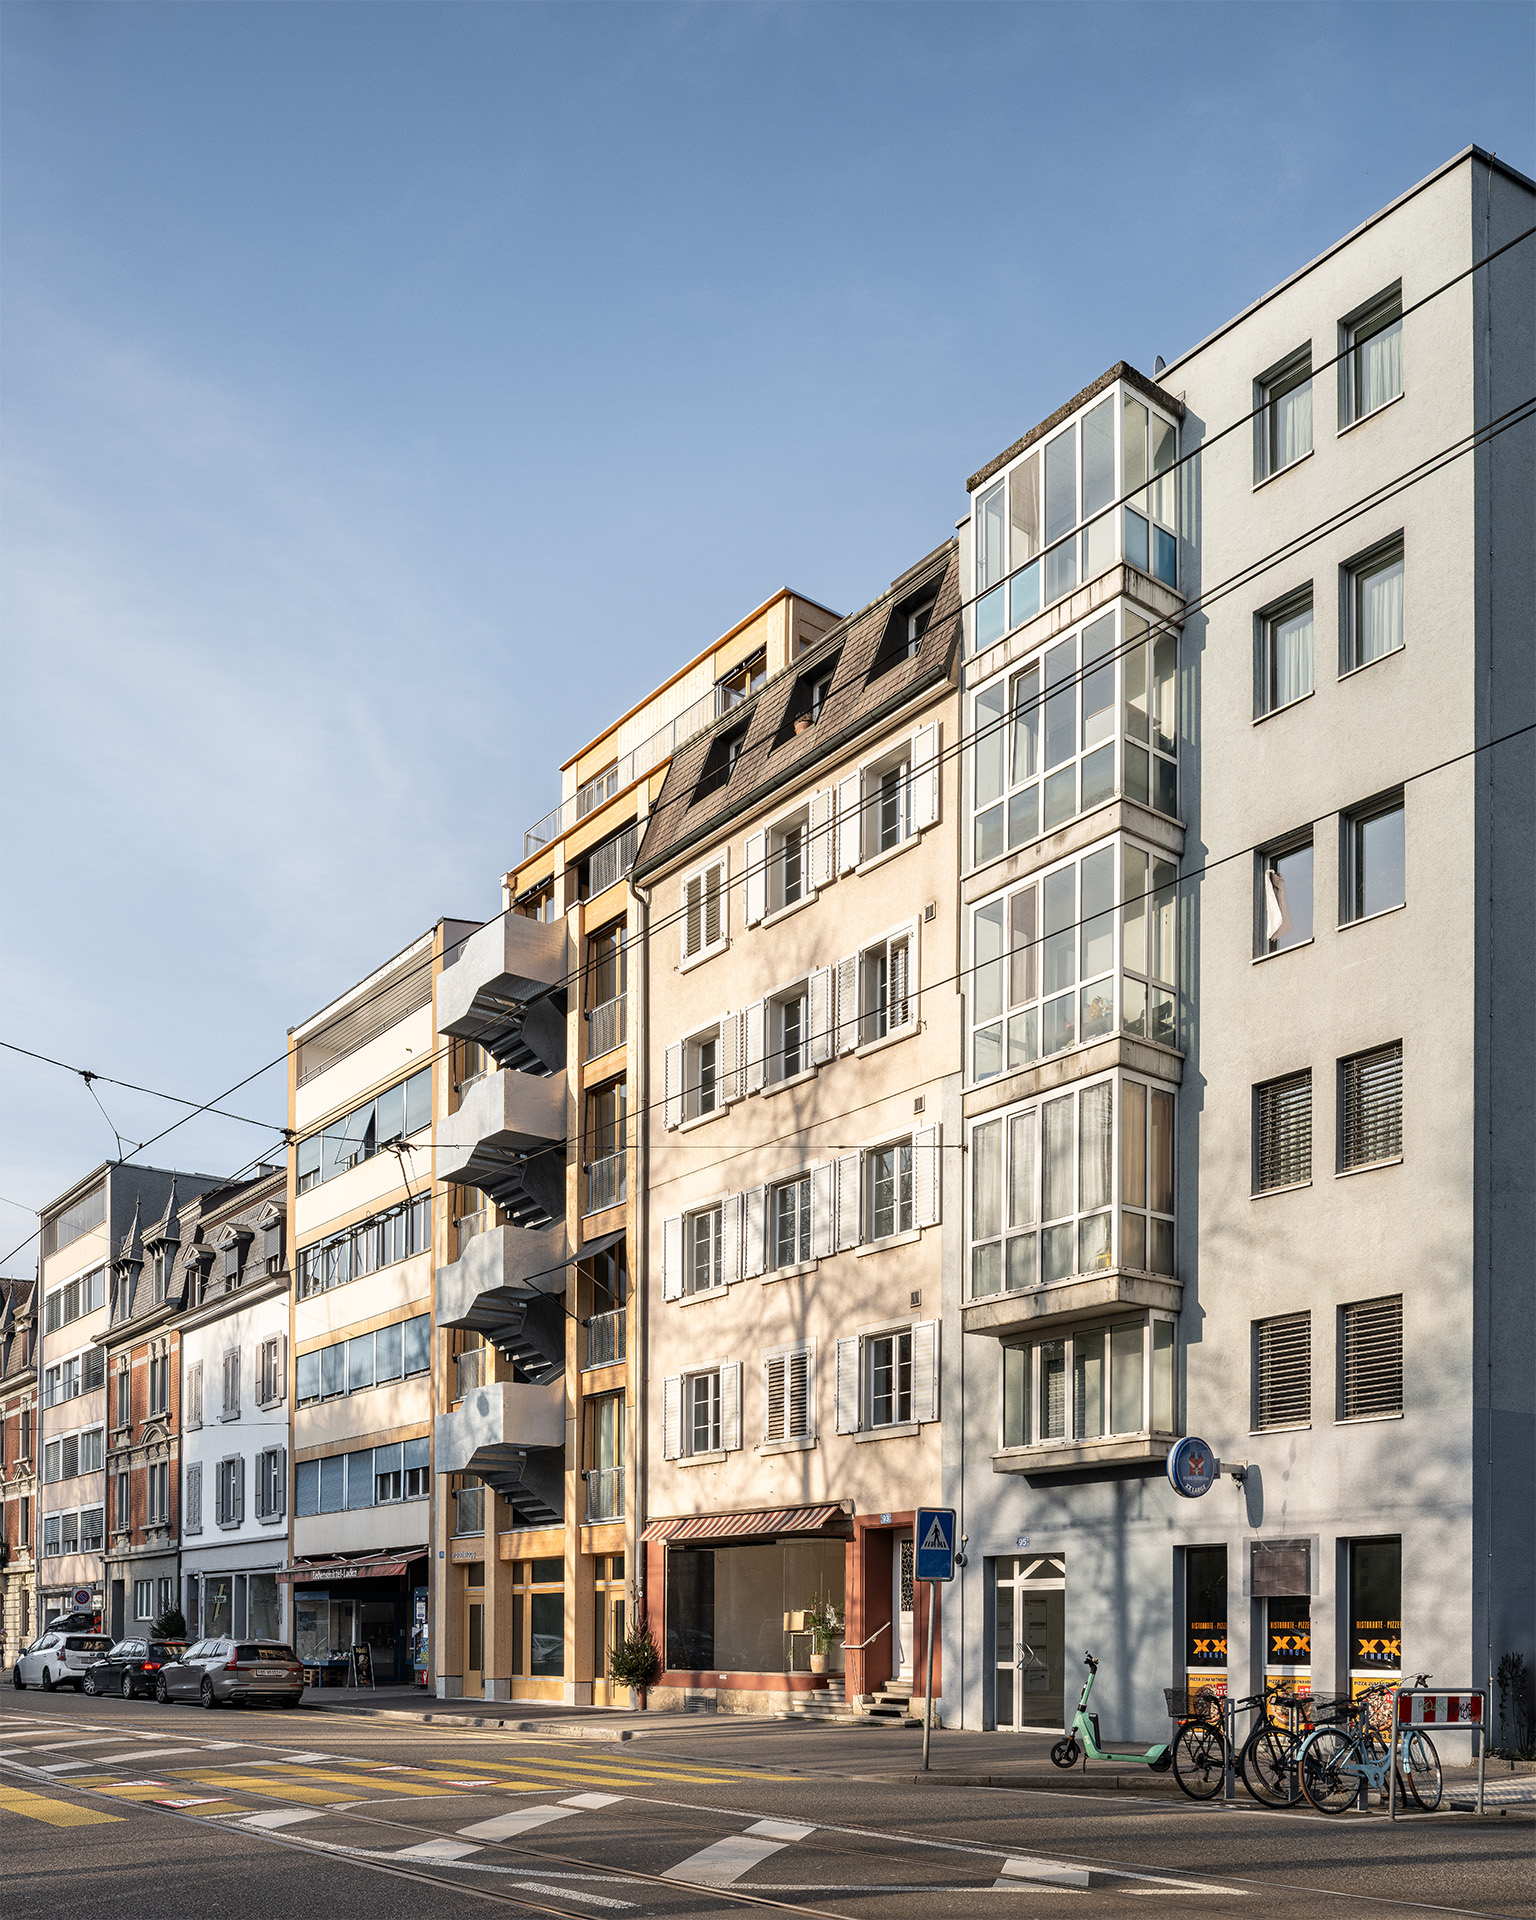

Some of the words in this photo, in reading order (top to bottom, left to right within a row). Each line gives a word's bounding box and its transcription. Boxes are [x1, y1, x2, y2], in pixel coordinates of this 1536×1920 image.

[1018, 1538, 1026, 1546] 95
[1270, 1621, 1294, 1629] RISTORANTE
[1356, 1621, 1383, 1629] RISTORANTE
[1193, 1639, 1227, 1654] XX
[1272, 1636, 1310, 1652] XX
[1358, 1639, 1401, 1656] XX
